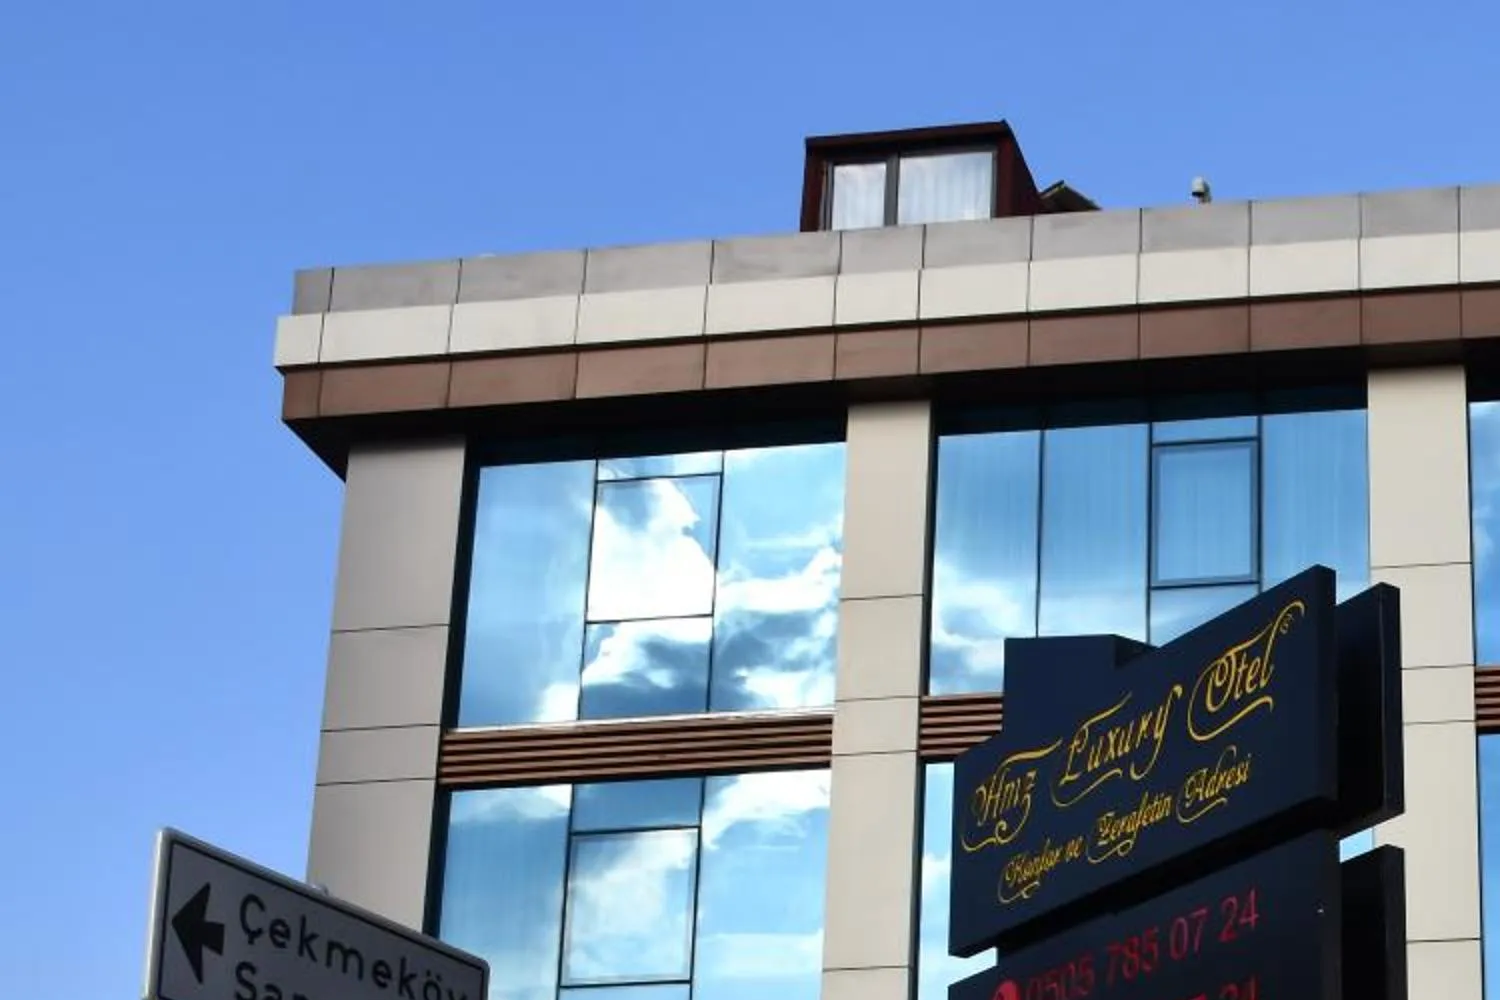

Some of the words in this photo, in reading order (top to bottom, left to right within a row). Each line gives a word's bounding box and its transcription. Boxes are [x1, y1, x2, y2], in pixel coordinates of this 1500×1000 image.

[961, 738, 1062, 852] Hmz
[1050, 684, 1184, 806] Luxury
[1186, 600, 1305, 741] Otel
[1106, 926, 1159, 987] 785
[1169, 908, 1208, 960] 07
[1218, 888, 1259, 942] 24
